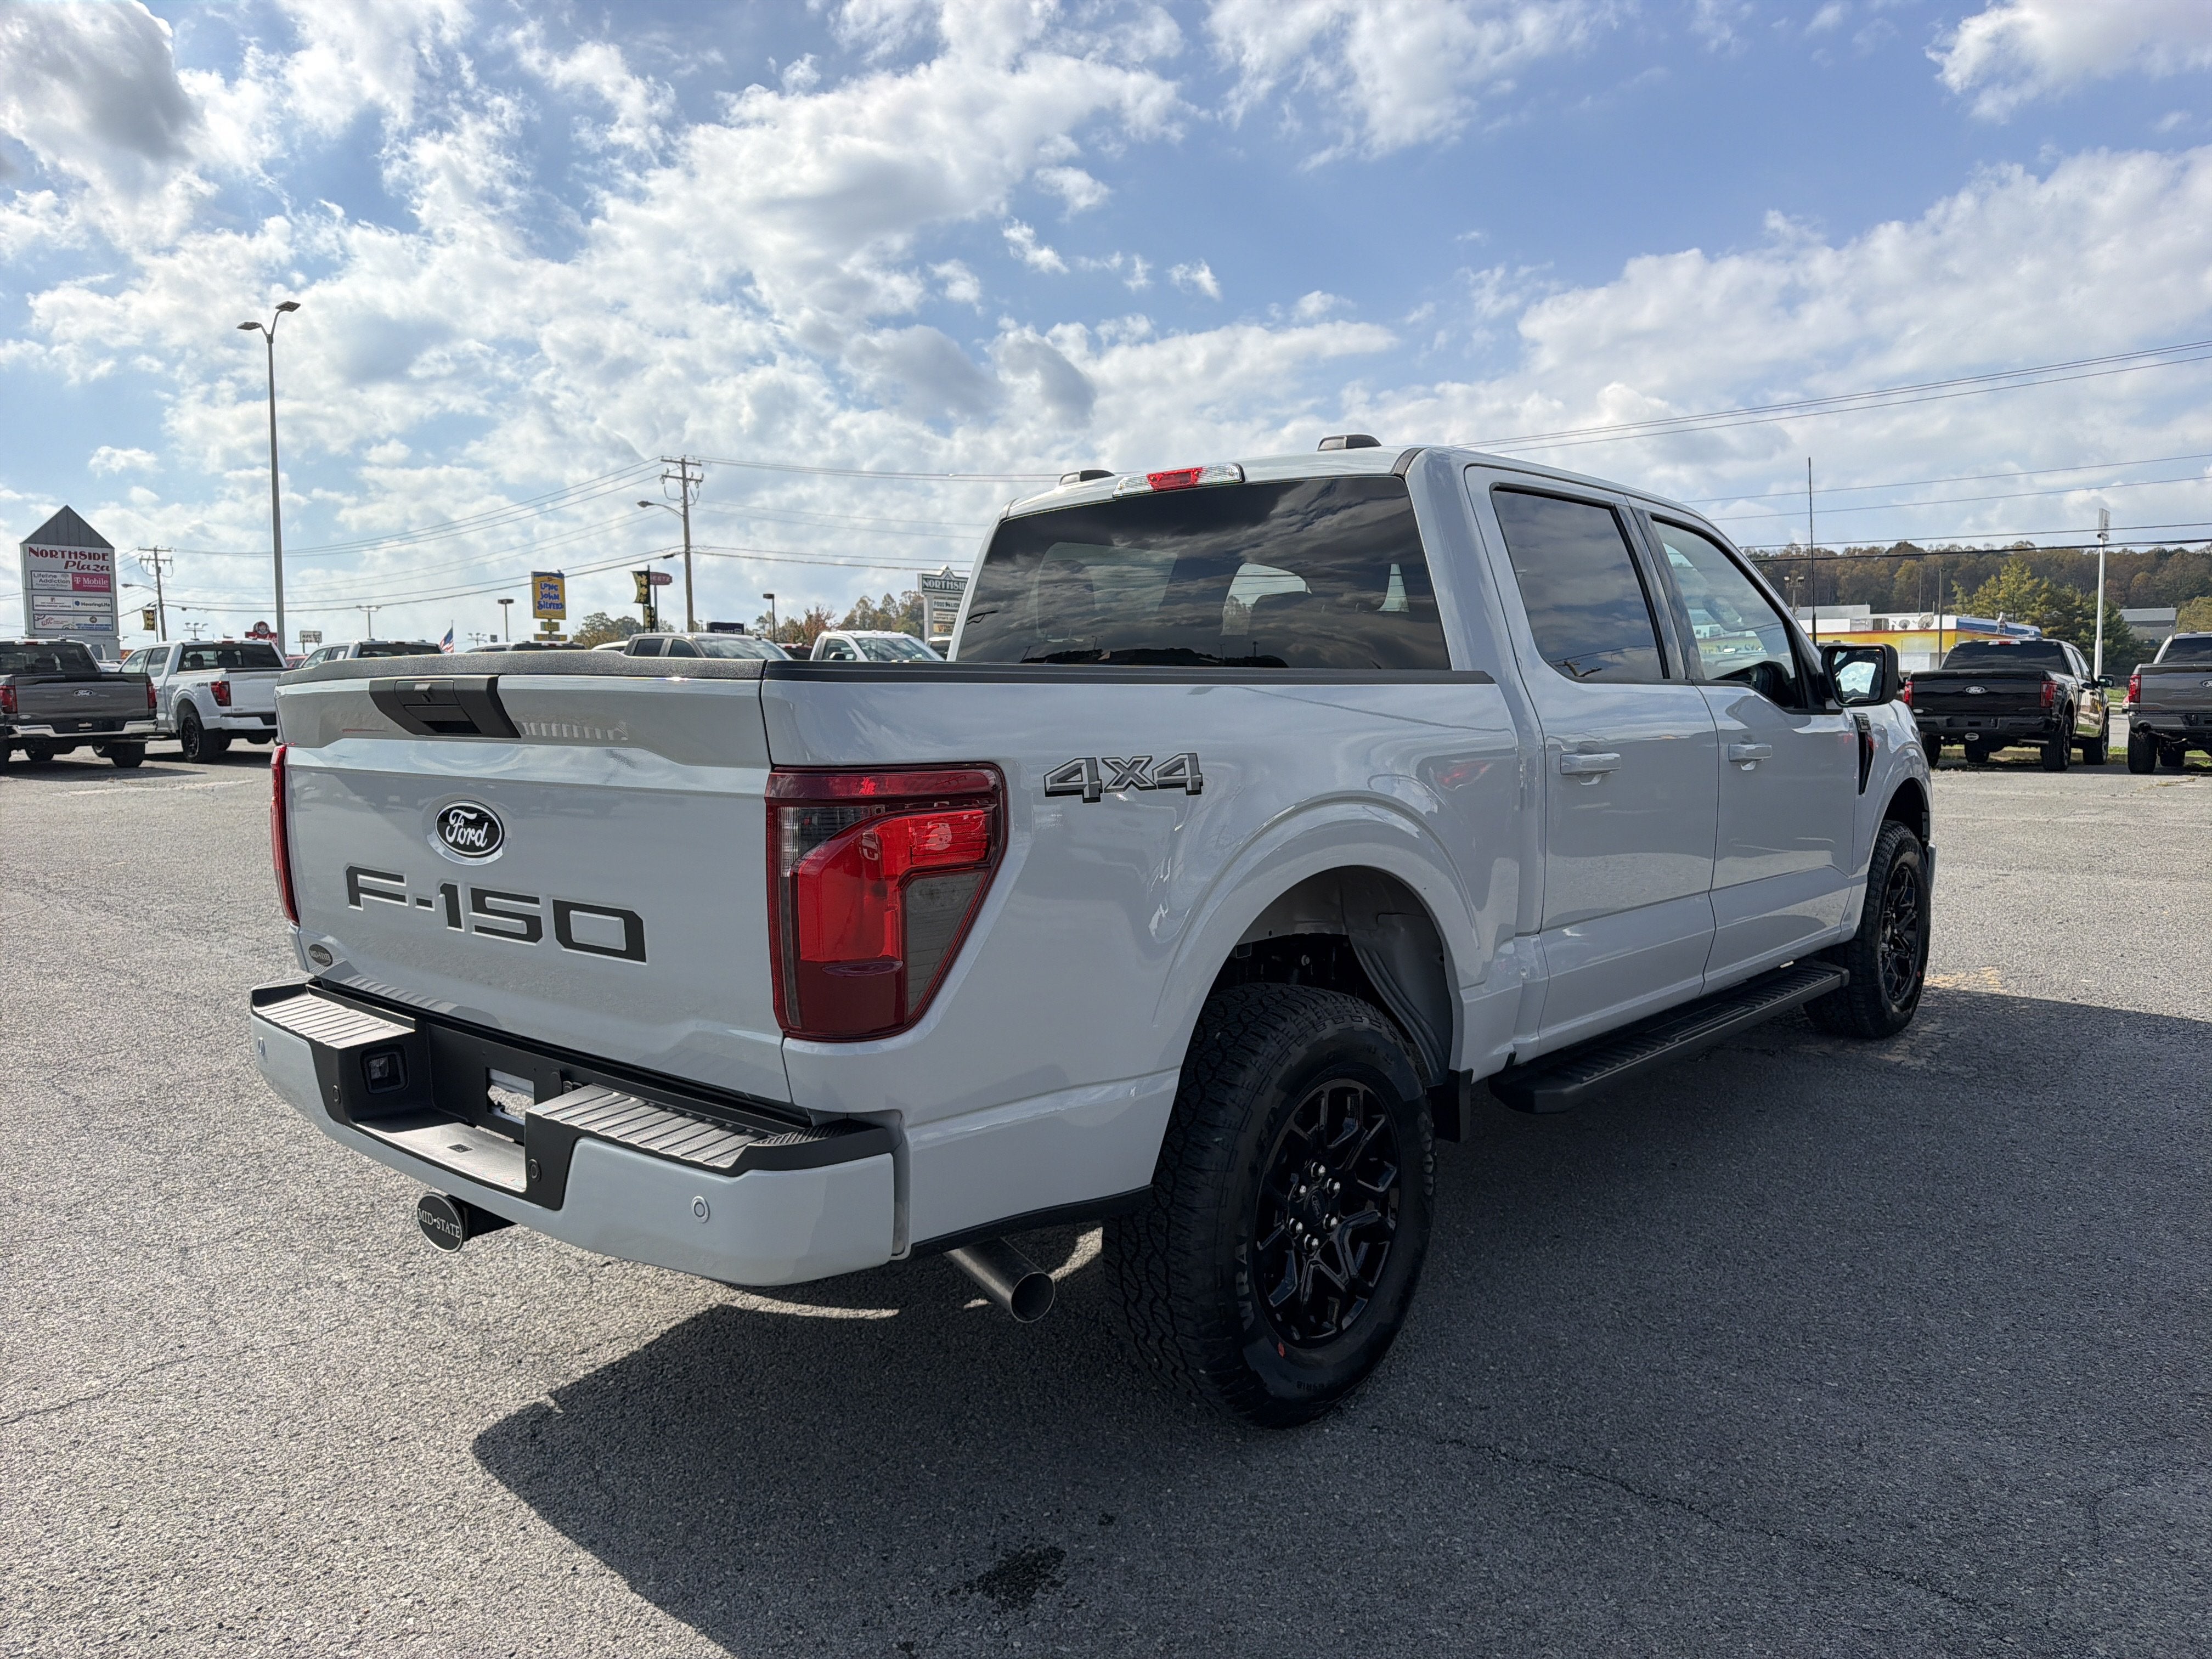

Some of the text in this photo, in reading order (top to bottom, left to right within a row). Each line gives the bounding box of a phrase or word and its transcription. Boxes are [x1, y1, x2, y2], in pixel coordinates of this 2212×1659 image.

[29, 547, 109, 561] NORTHSIDE
[64, 560, 110, 572] Plaza
[445, 809, 488, 848] Ford
[345, 865, 647, 965] F-150
[417, 1207, 460, 1239] MID-STATE
